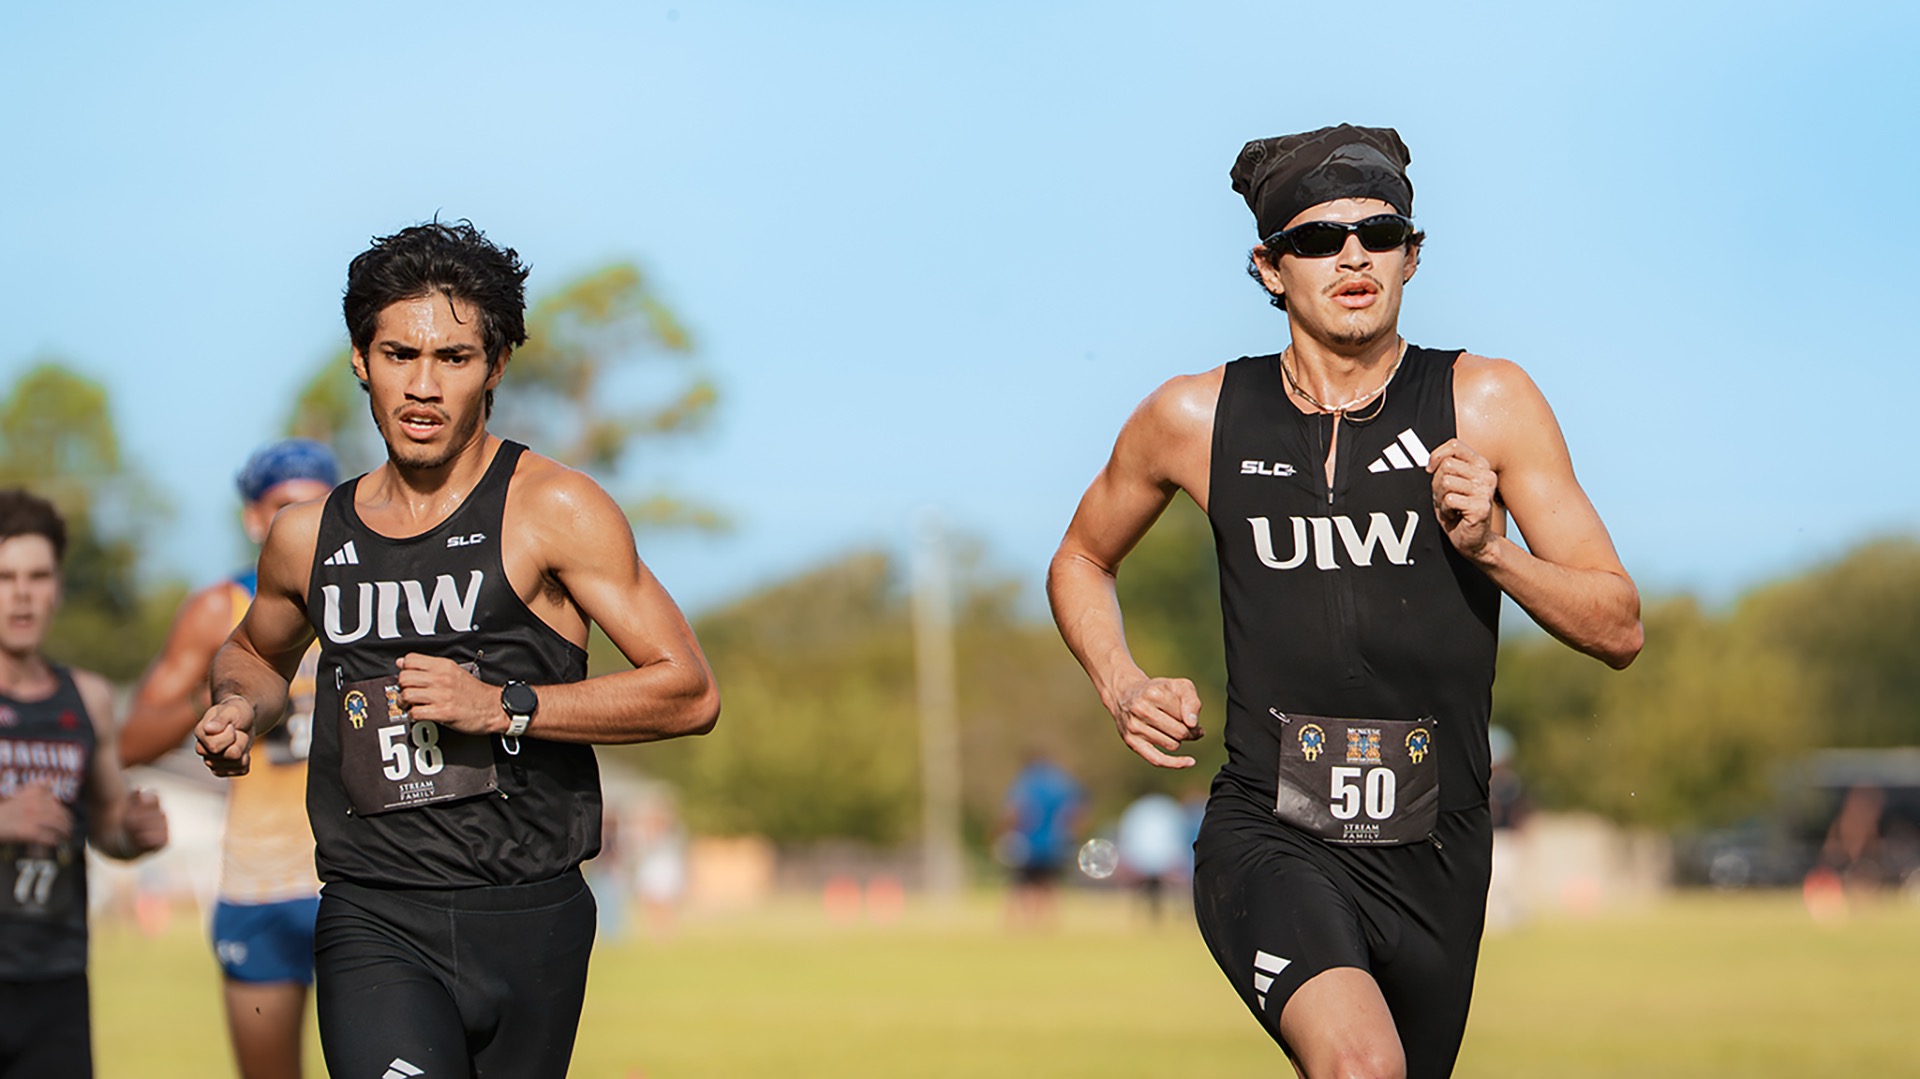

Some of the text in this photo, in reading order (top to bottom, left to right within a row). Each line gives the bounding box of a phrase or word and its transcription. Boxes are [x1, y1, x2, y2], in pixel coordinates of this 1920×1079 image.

[1246, 510, 1420, 571] UIW
[321, 569, 484, 645] UIW
[377, 720, 444, 782] 58
[398, 780, 434, 791] STREAM
[400, 788, 435, 801] FAMILY
[1329, 766, 1396, 820] 50
[13, 858, 58, 905] 77
